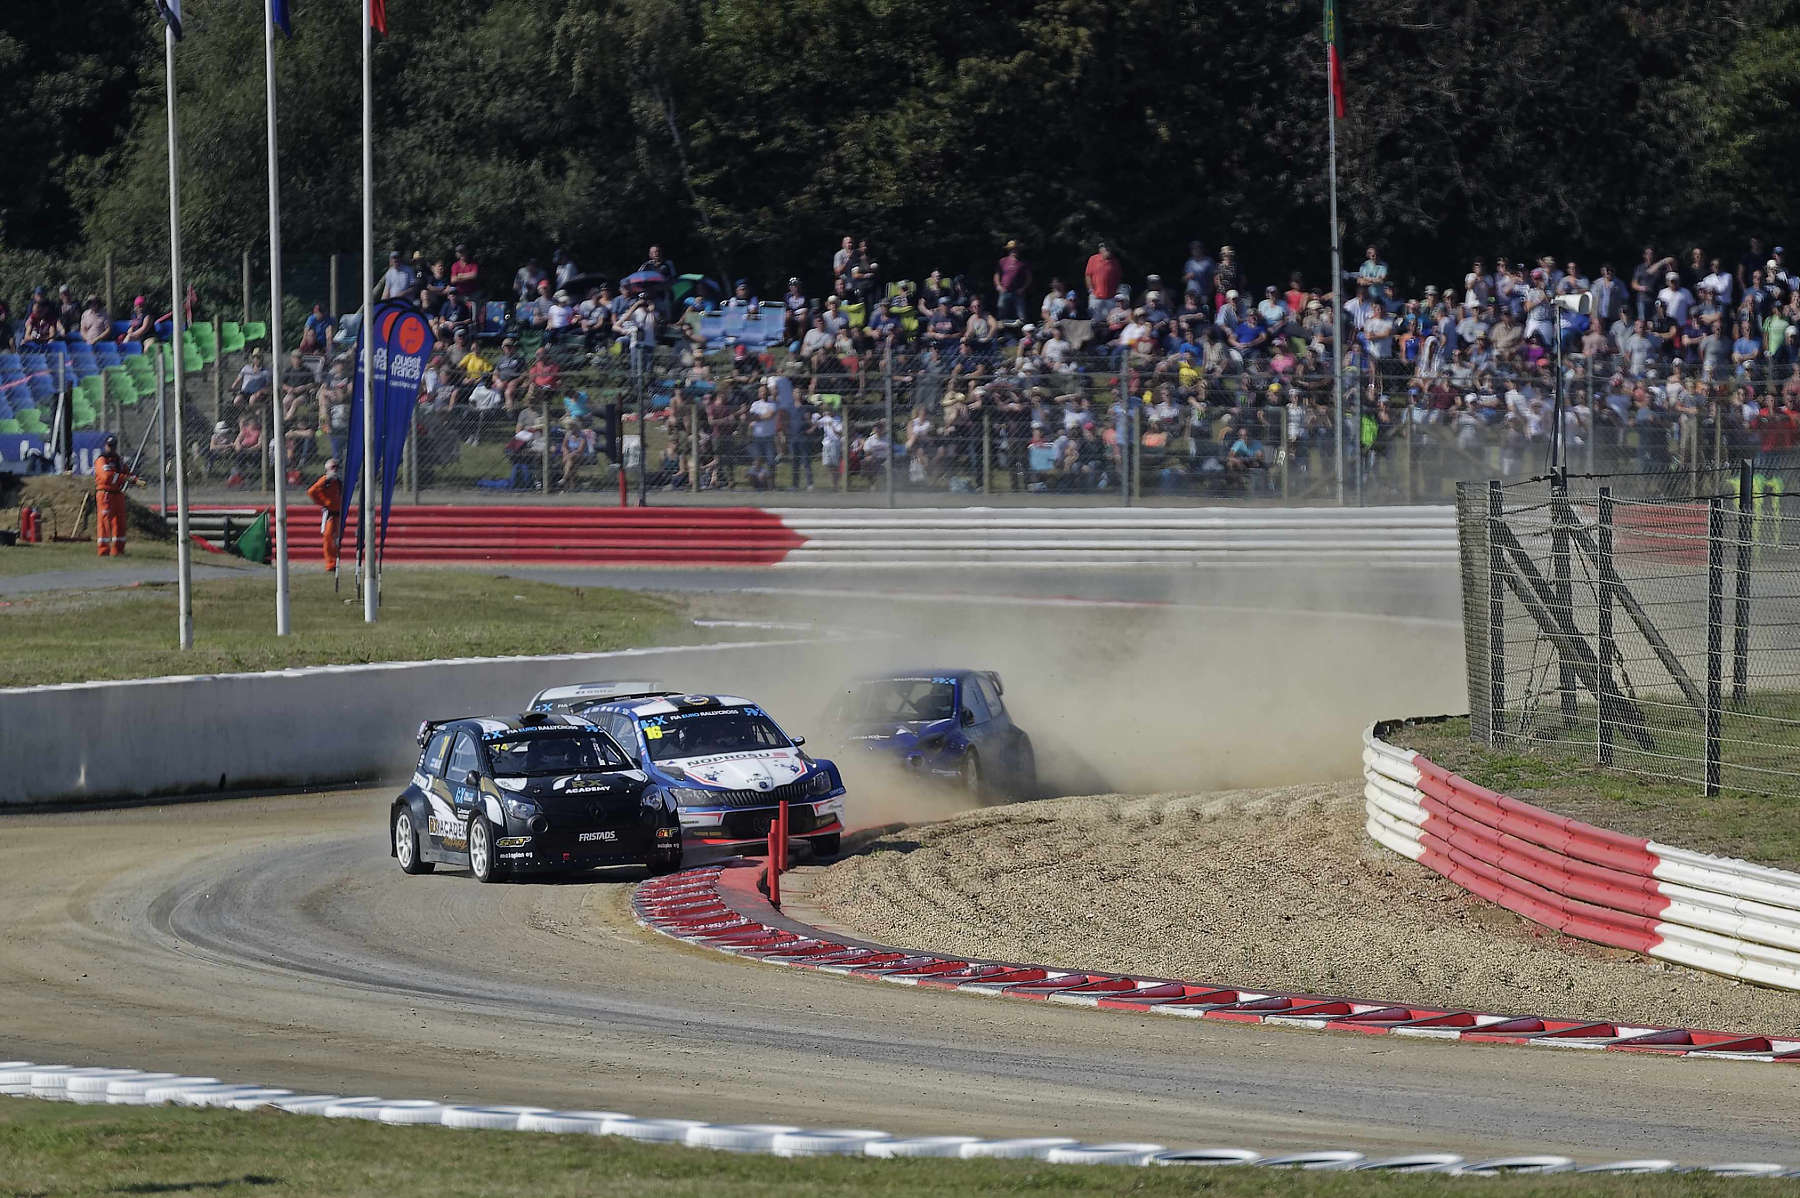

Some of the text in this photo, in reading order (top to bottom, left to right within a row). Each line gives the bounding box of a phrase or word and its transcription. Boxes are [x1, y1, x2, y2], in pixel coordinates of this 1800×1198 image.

[700, 709, 739, 717] RALLYCROSS
[537, 724, 578, 732] RALLYCROSS
[644, 725, 663, 740] 16
[687, 753, 770, 766] NOPROSU
[565, 786, 611, 794] ACADEMY
[579, 831, 616, 842] FRISTADS
